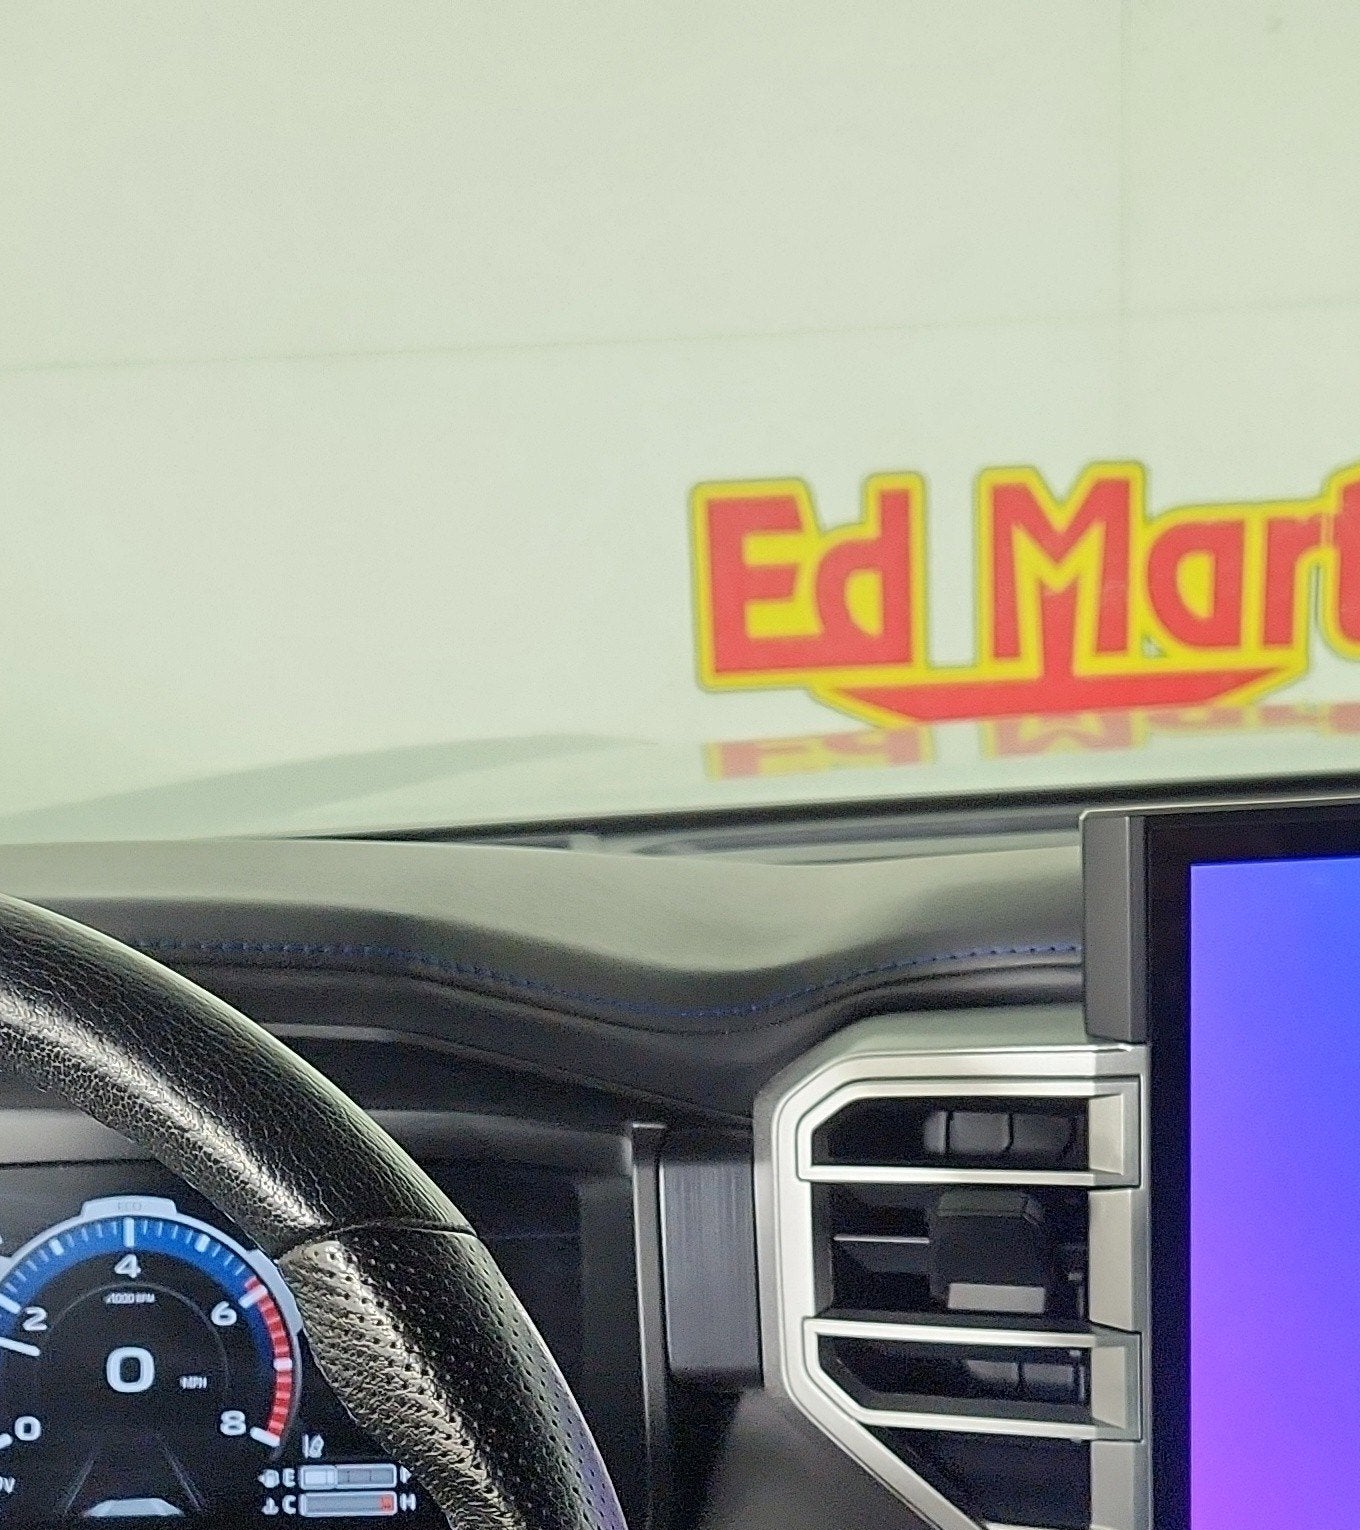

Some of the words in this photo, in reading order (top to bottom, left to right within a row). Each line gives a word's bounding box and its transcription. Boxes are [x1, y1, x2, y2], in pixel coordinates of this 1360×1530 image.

[700, 478, 922, 684] Ed
[114, 1253, 141, 1279] 4
[22, 1306, 48, 1331] 2
[211, 1301, 238, 1326] 6
[105, 1346, 155, 1393] 0
[13, 1415, 42, 1442] 0
[219, 1409, 247, 1436] 8
[282, 1468, 296, 1488] E
[281, 1494, 297, 1515] C
[399, 1493, 417, 1512] H
